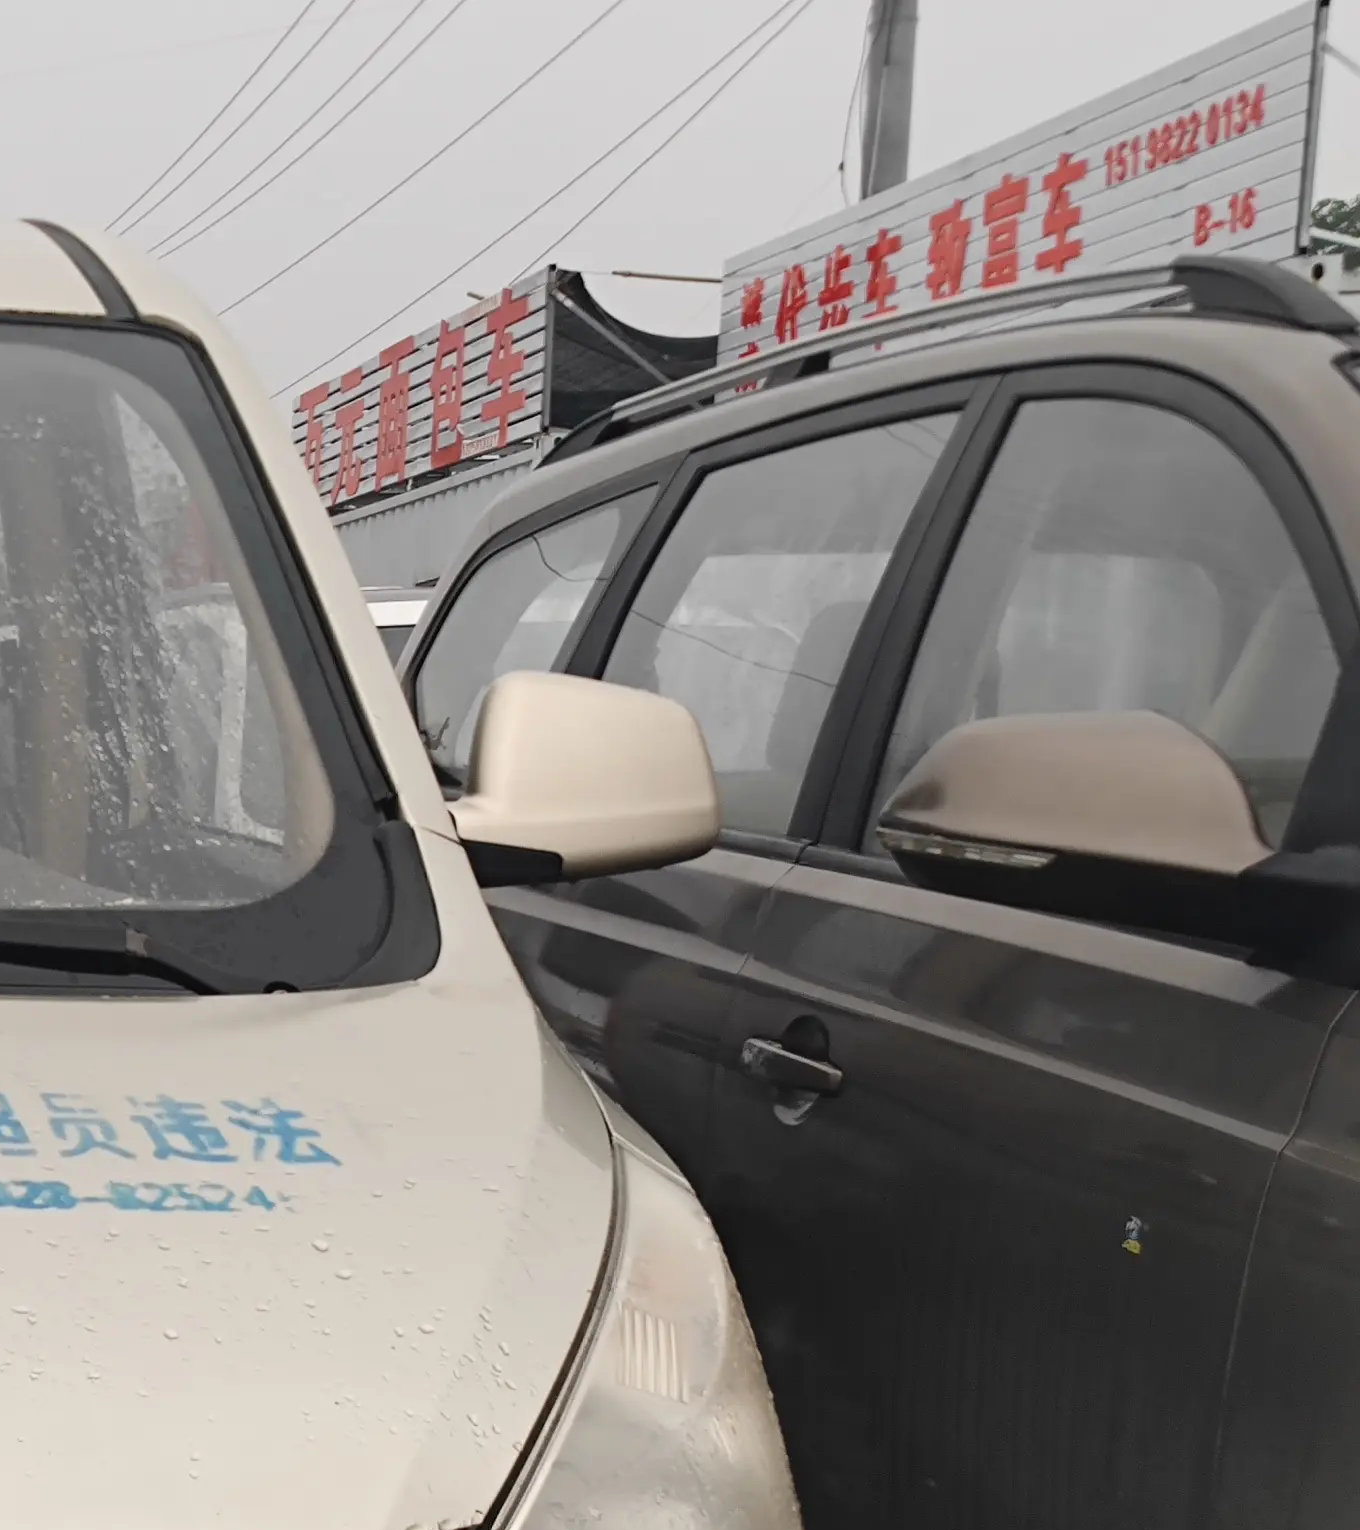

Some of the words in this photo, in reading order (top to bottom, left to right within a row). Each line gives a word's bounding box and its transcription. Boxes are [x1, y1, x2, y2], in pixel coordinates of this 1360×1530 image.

[1104, 135, 1141, 187] 151
[926, 153, 1089, 302] 致富车
[1194, 187, 1259, 248] B-16
